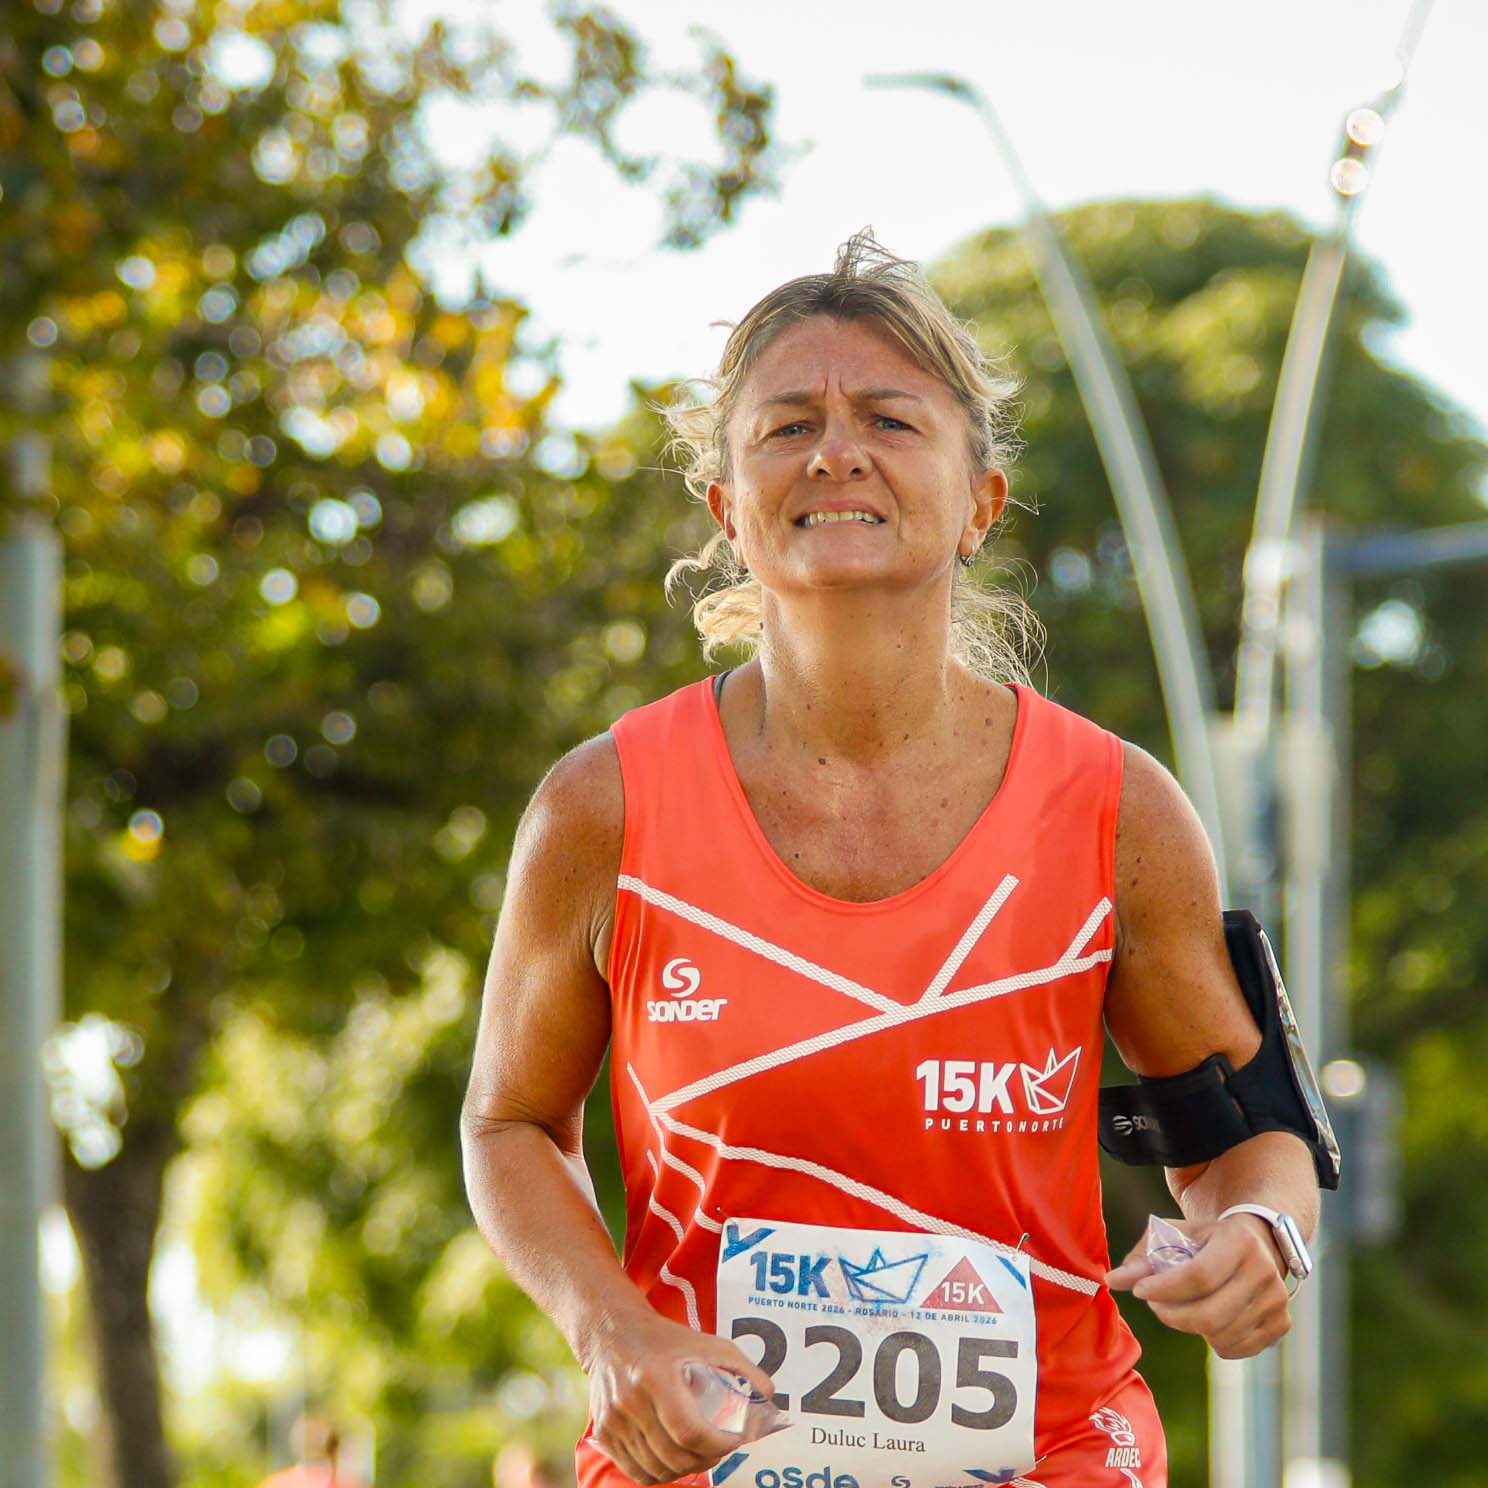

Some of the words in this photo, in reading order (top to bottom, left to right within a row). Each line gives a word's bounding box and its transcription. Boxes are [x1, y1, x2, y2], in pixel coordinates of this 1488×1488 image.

[916, 1060, 1016, 1114] 15K
[749, 1250, 833, 1298] 15K
[940, 1280, 985, 1305] 15K
[747, 1296, 785, 1308] PUERTO
[787, 1302, 818, 1312] NORTE
[821, 1304, 845, 1315] 2026
[855, 1307, 898, 1318] ROSARIO
[910, 1311, 921, 1320] 12
[925, 1312, 937, 1321] DE
[941, 1313, 970, 1323] ABRIL
[973, 1315, 998, 1325] 2026
[731, 1317, 1019, 1430] 2205
[811, 1427, 866, 1448] Duluc
[873, 1432, 926, 1453] Laura
[1105, 1448, 1142, 1468] ARDEC
